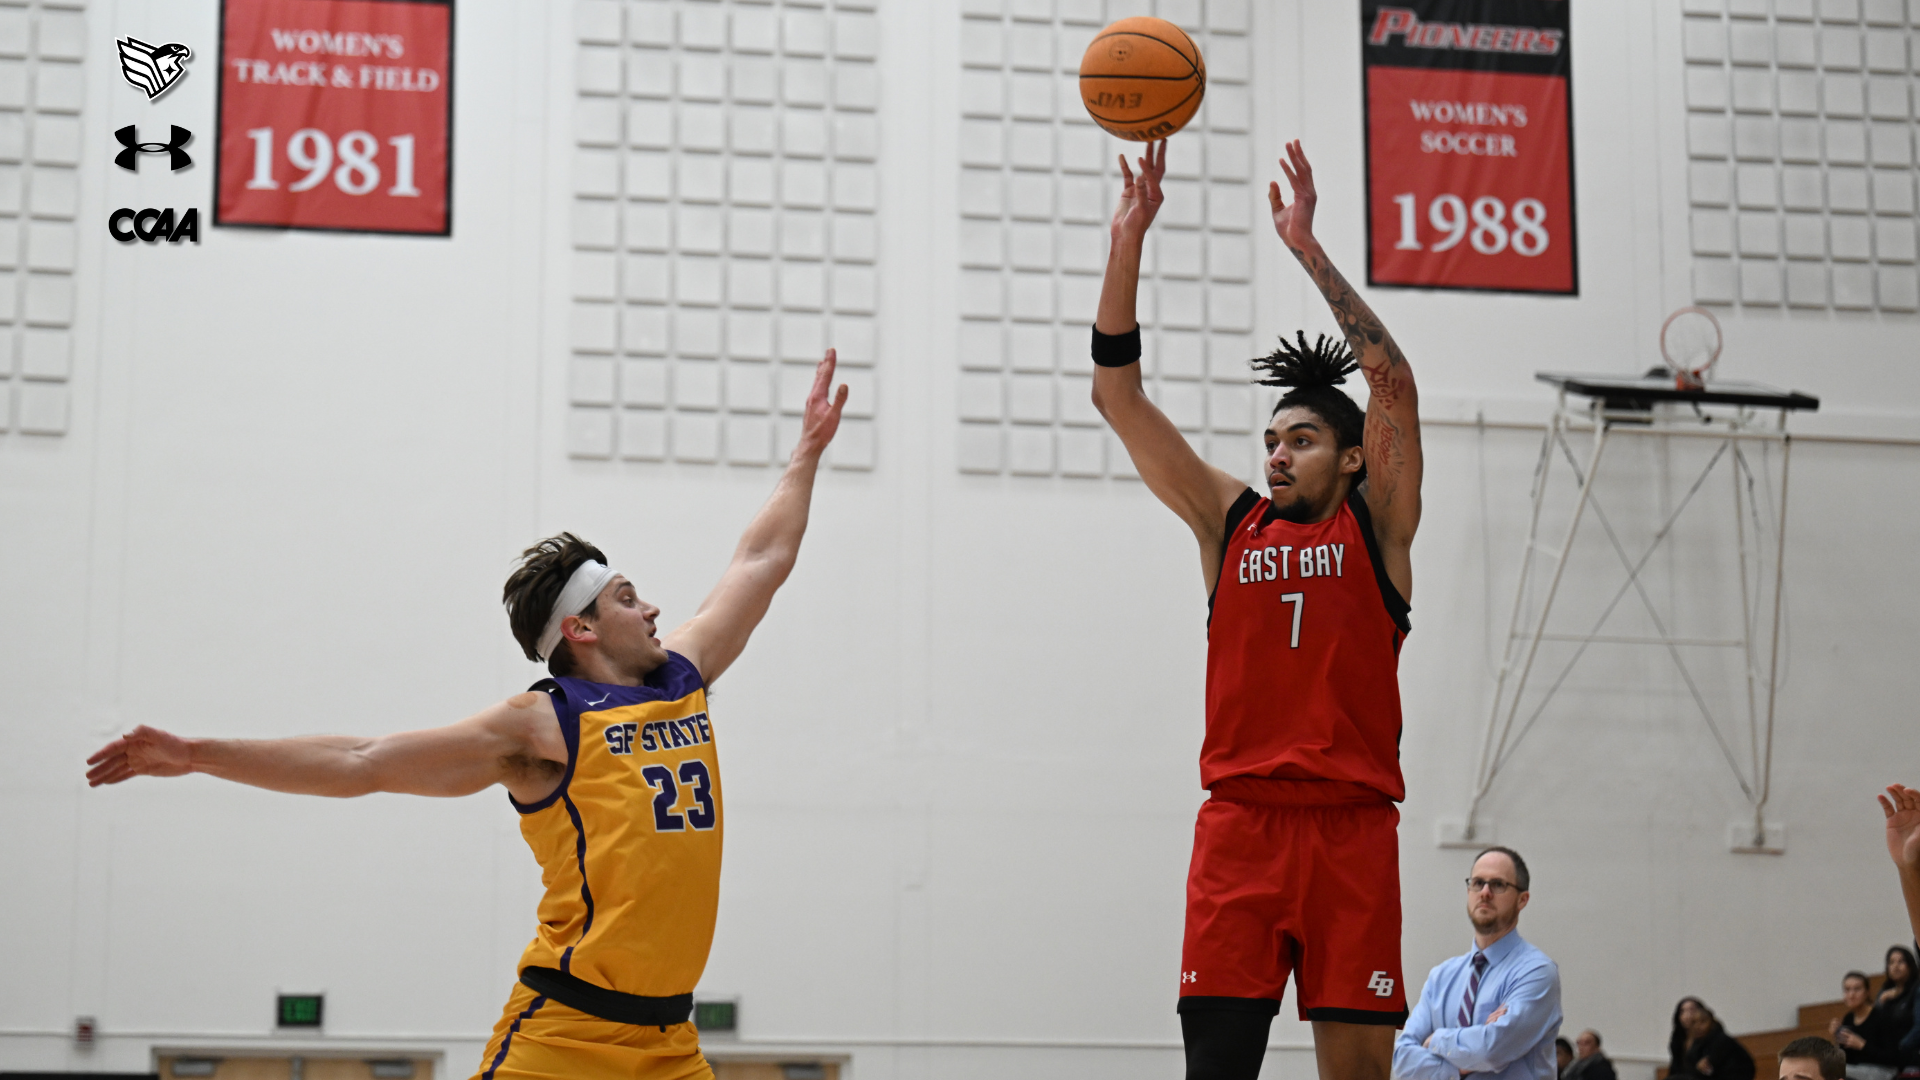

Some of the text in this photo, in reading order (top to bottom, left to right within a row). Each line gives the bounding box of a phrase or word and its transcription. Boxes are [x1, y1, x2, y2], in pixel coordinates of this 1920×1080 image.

[271, 28, 404, 59] WOMEN'S
[232, 58, 440, 93] TRACK & FIELD
[1410, 99, 1528, 128] WOMEN'S
[245, 126, 421, 197] 1981
[1419, 130, 1518, 158] SOCCER
[1392, 192, 1550, 257] 1988
[1238, 543, 1345, 584] EAST BAY
[1280, 592, 1304, 649] 7
[603, 711, 711, 755] SF STATE
[641, 759, 716, 832] 23
